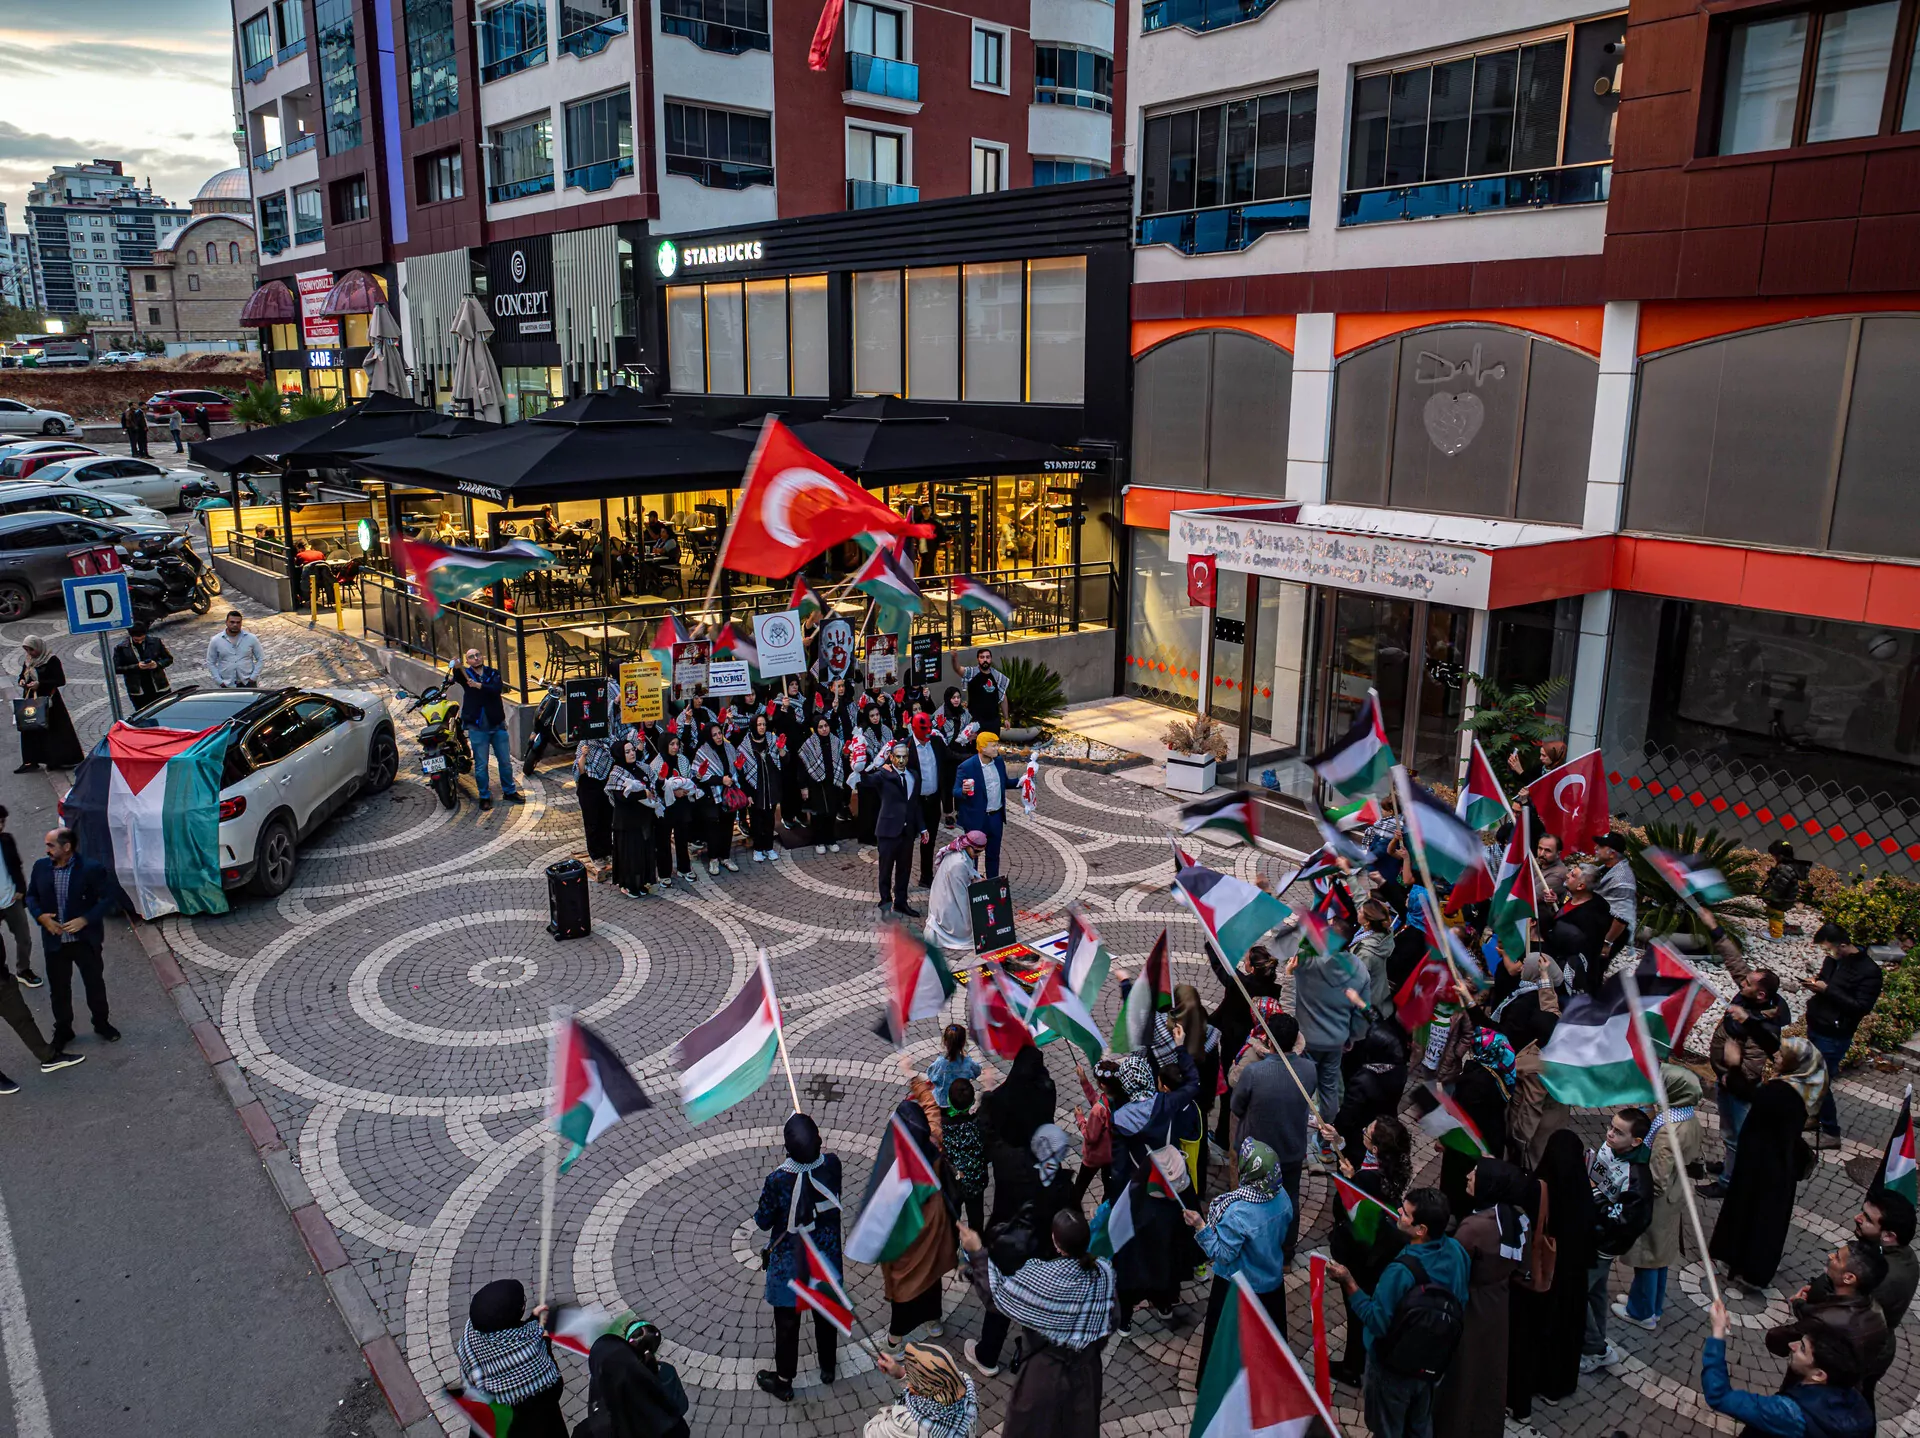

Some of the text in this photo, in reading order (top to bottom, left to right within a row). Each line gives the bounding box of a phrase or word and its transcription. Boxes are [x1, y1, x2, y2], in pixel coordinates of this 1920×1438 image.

[684, 241, 762, 266] STARBUCKS
[495, 291, 549, 317] CONCEPT
[310, 351, 331, 367] SADE
[1043, 460, 1097, 470] STARBUCKS
[457, 480, 503, 501] STARBUCKS
[84, 589, 113, 619] D
